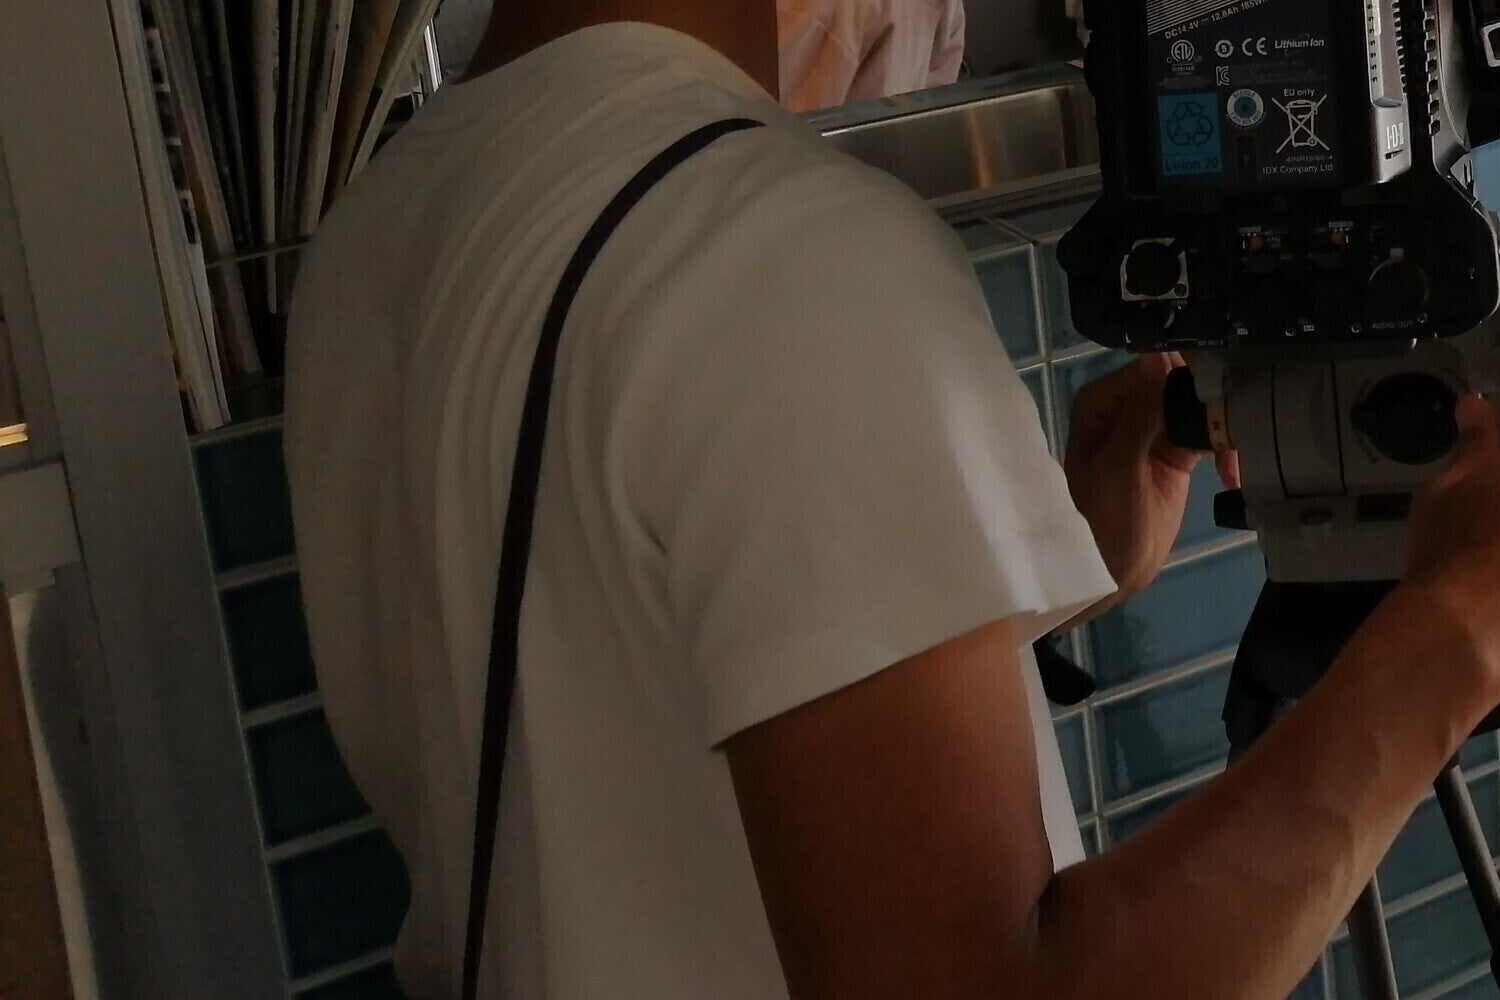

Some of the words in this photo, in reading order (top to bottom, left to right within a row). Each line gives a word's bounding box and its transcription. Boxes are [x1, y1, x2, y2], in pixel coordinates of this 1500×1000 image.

[1274, 38, 1309, 50] Lithium
[1309, 37, 1325, 48] Ion
[1283, 89, 1296, 97] EU
[1296, 88, 1316, 97] only
[1262, 166, 1278, 175] IDX
[1279, 164, 1318, 175] Company
